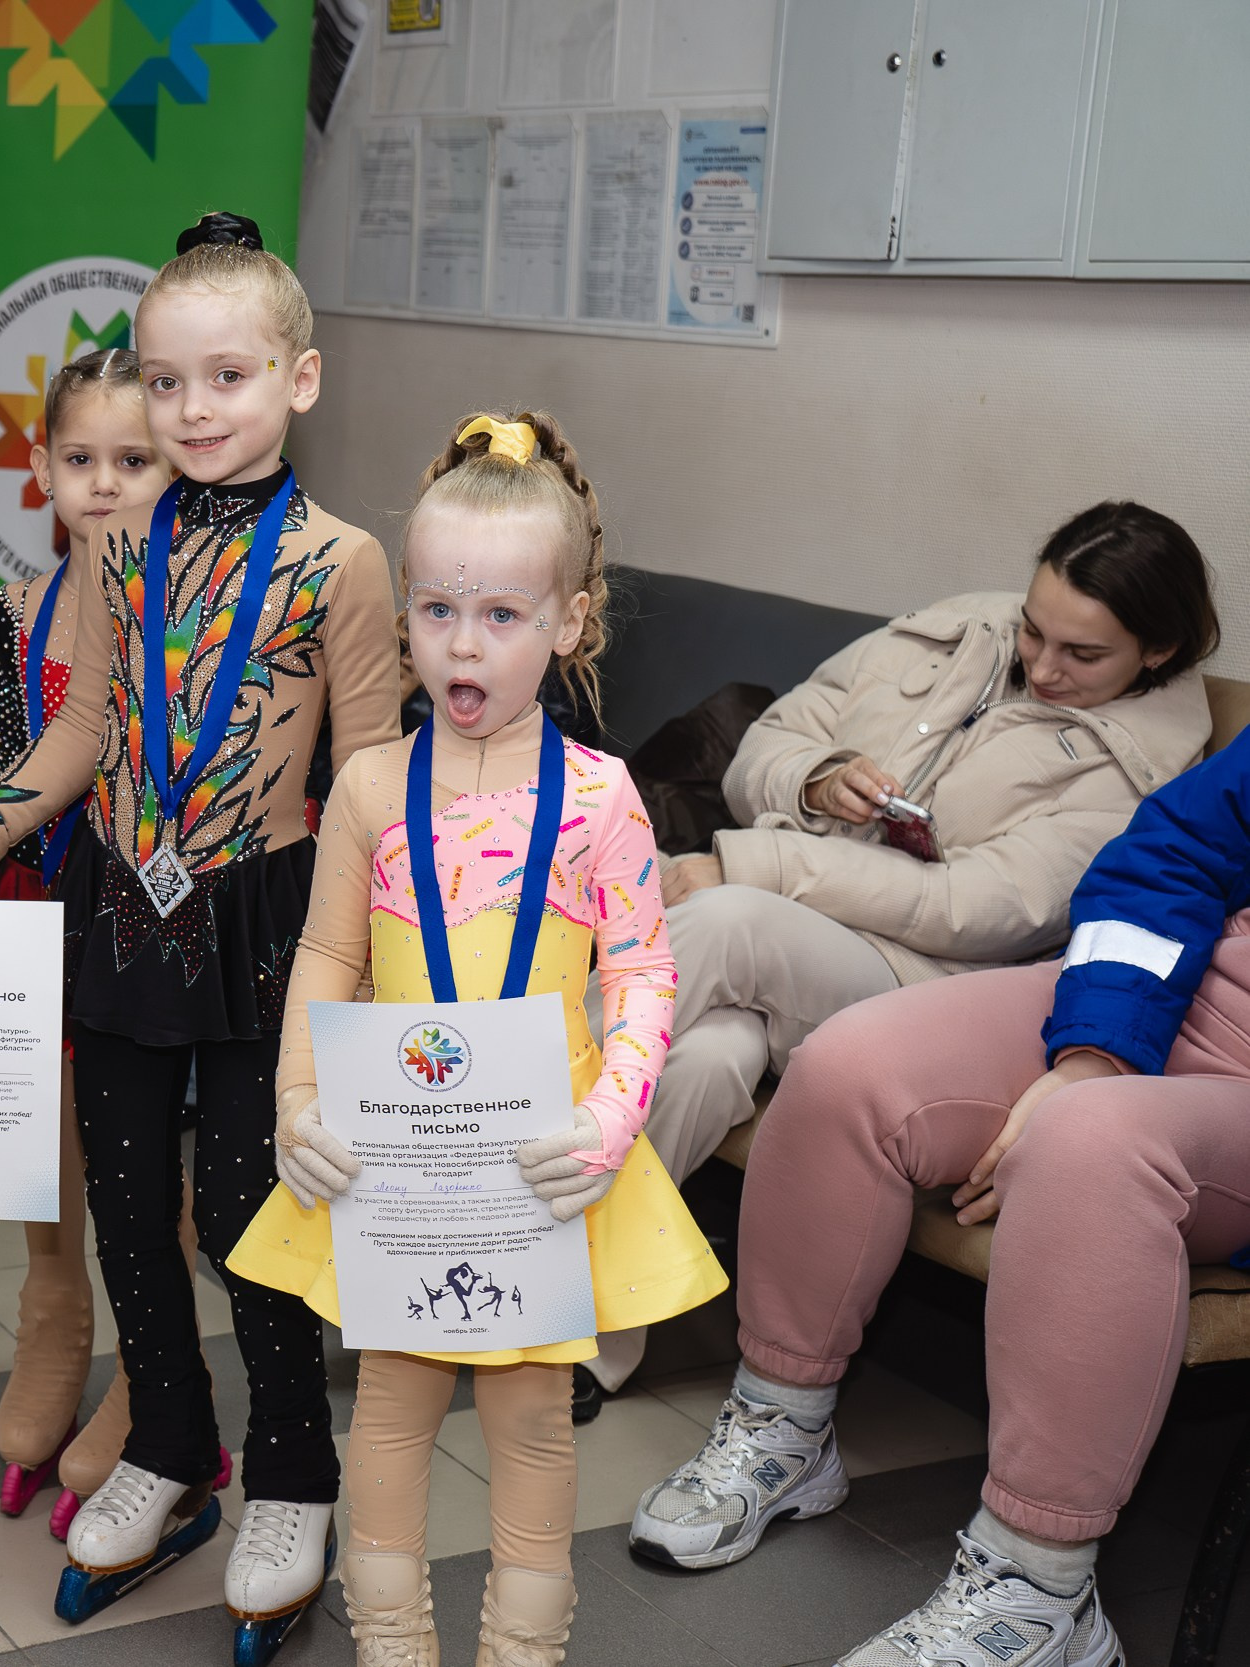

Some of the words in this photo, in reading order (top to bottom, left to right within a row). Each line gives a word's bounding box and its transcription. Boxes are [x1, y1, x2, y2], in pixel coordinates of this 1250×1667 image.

[49, 269, 148, 297] ОБЩЕСТВЕННА
[0, 1036, 41, 1044] фигурного
[359, 1098, 532, 1117] Благодарственное
[411, 1123, 480, 1134] письмо
[352, 1140, 410, 1150] Региональная
[411, 1142, 475, 1151] общественная
[392, 1152, 448, 1160] организация
[450, 1149, 505, 1159] «Федерация
[434, 1159, 504, 1169] Новосибирской
[422, 1170, 473, 1178] благодарит
[404, 1207, 445, 1215] фигурного
[480, 1203, 529, 1213] стремление
[377, 1215, 431, 1223] совершенству
[476, 1213, 510, 1222] ледовой
[366, 1231, 416, 1239] пожеланием
[442, 1232, 493, 1240] достижений
[501, 1229, 526, 1238] ярких
[527, 1224, 555, 1234] побед!
[373, 1239, 395, 1248] Пусть
[396, 1241, 426, 1249] каждое
[427, 1241, 479, 1249] выступление
[480, 1239, 506, 1248] дарит
[445, 1248, 496, 1257] приближает
[503, 1244, 530, 1253] мечте!
[751, 1458, 789, 1492] N
[973, 1620, 1030, 1661] N
